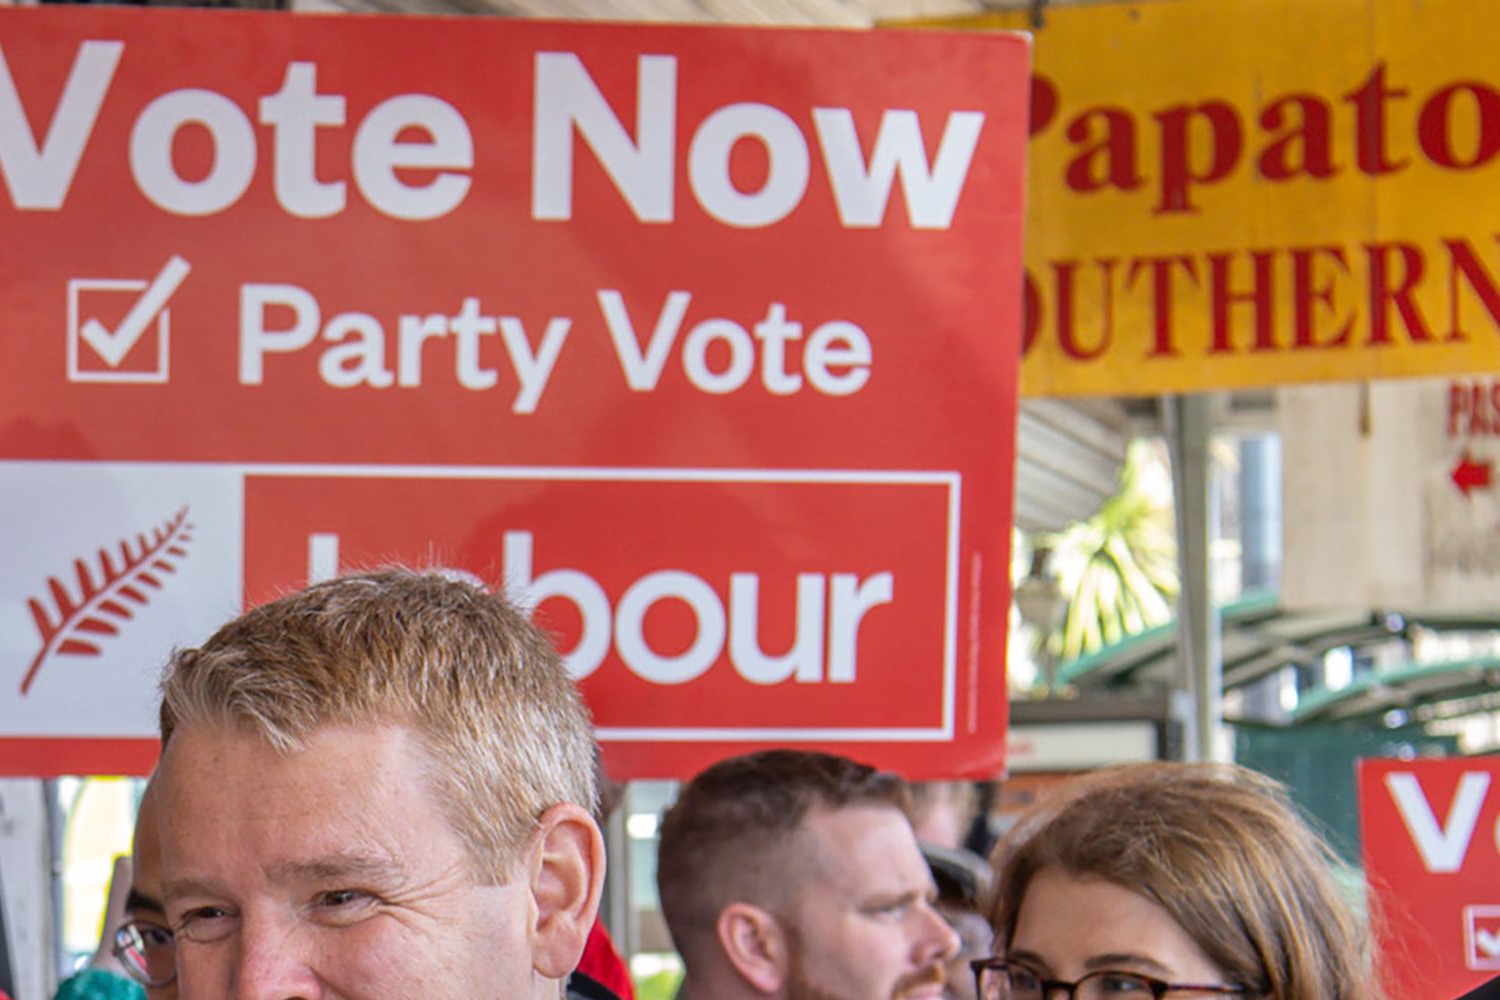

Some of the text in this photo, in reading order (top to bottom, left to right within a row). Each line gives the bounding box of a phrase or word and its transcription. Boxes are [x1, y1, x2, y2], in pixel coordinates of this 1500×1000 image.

[532, 51, 986, 230] Now
[239, 282, 873, 415] Party Vote
[308, 530, 895, 686] bour
[1384, 771, 1500, 874] V
